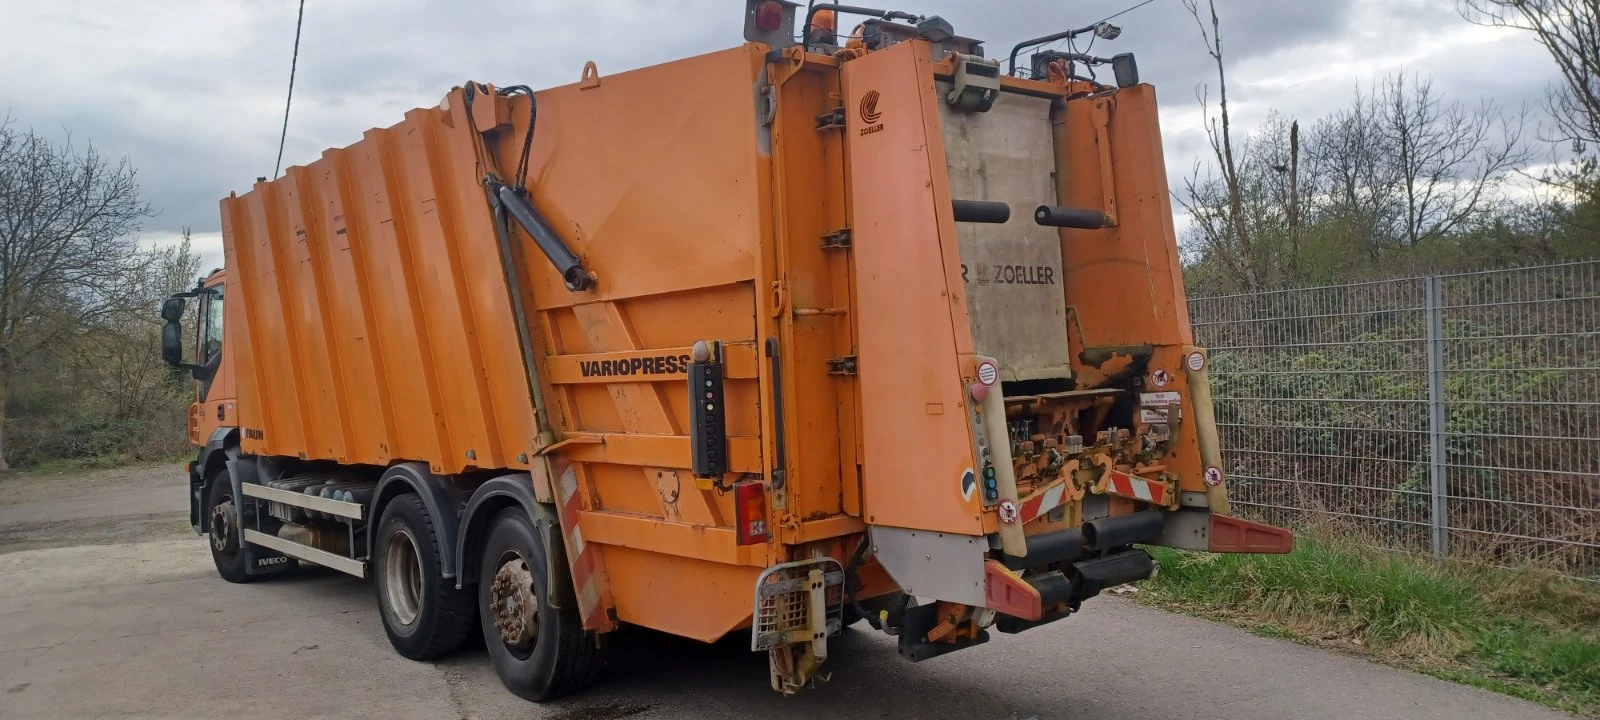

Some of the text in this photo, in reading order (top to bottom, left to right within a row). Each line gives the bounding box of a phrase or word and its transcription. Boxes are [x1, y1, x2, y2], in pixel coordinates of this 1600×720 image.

[860, 124, 884, 136] ZOELLER
[993, 264, 1055, 285] ZOELLER
[580, 355, 691, 377] VARIOPRESS
[258, 556, 288, 566] IVECO
